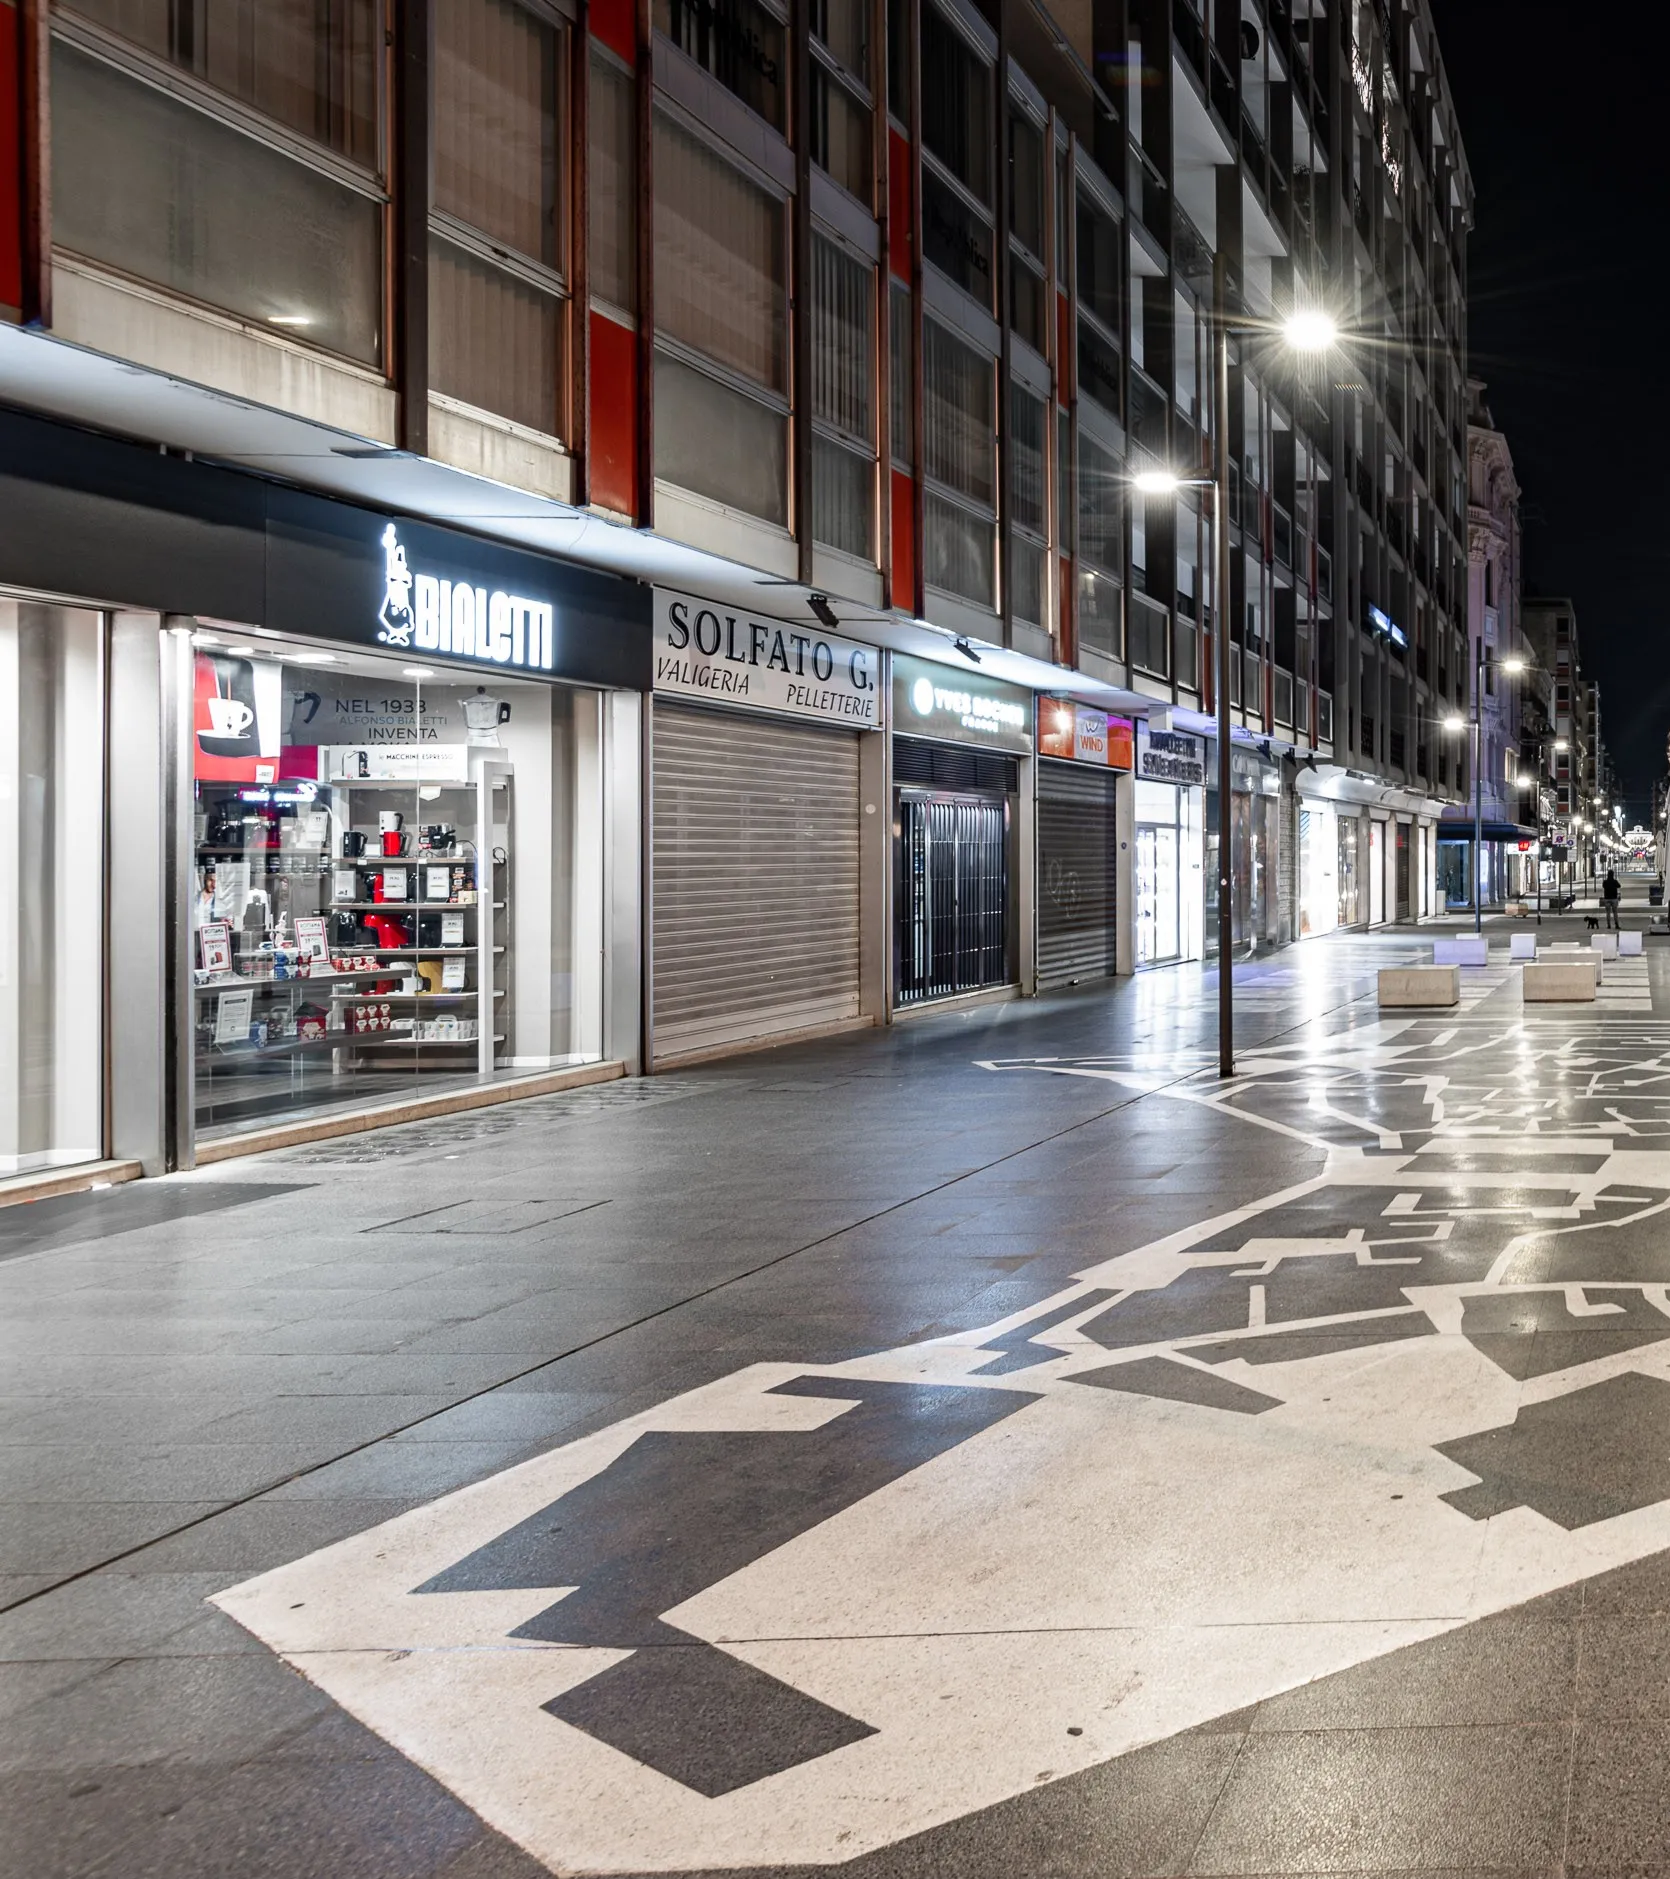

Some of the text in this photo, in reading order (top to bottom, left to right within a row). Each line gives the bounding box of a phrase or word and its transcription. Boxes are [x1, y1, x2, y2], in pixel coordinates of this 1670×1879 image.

[414, 573, 552, 669] BIALETTI
[667, 602, 874, 692] SOLFATO G.
[657, 657, 873, 718] VALIGERIA PELLETTERIE
[335, 700, 427, 714] NEL 1933
[339, 716, 395, 725] ALFONSO
[368, 728, 438, 739] INVENTA
[1080, 735, 1104, 753] WIND
